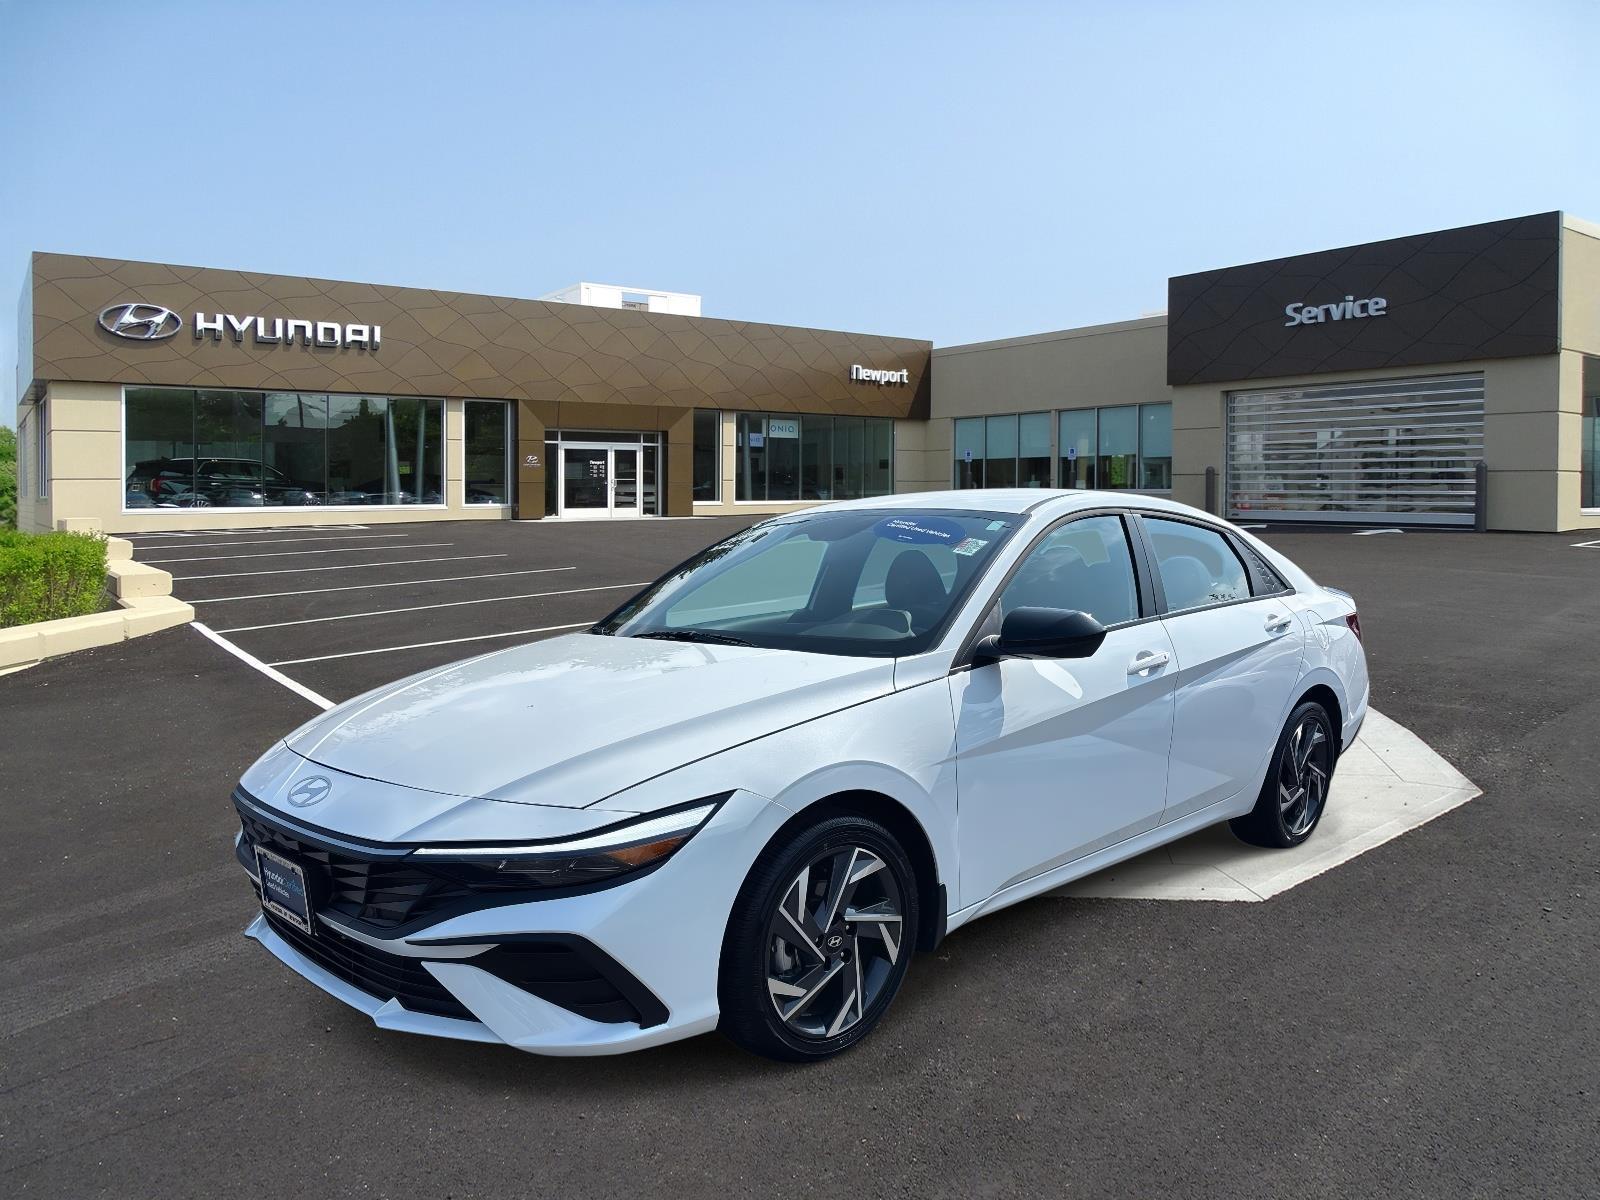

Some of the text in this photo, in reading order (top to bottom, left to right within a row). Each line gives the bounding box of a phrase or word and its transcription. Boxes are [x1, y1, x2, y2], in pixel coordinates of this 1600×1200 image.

[1285, 295, 1387, 327] Service
[194, 312, 382, 350] HYUNDAI
[850, 364, 909, 385] Newport
